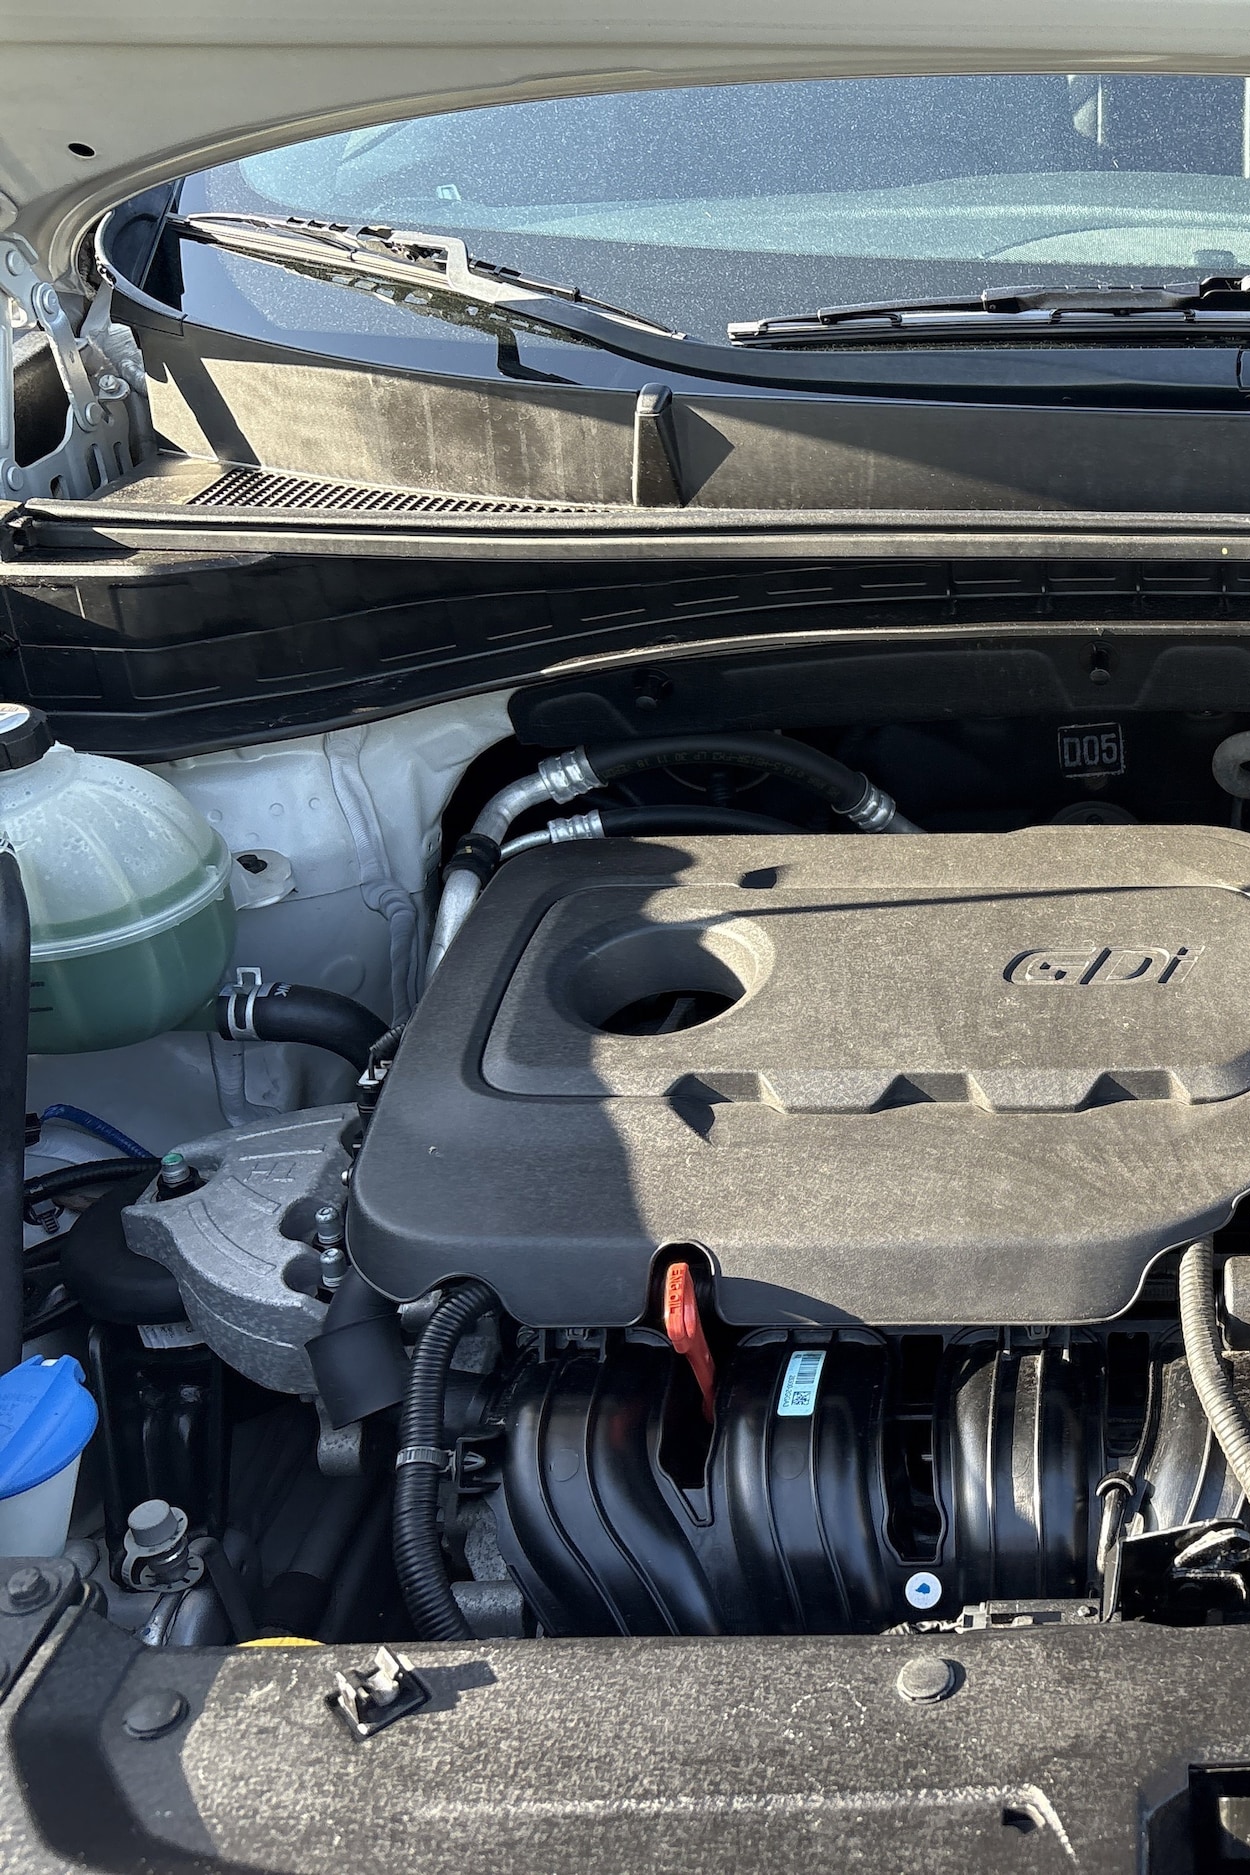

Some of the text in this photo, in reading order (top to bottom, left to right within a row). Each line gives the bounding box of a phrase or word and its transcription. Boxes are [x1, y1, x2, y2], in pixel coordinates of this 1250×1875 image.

[1063, 733, 1118, 768] D05
[669, 1269, 684, 1314] ENG OIL
